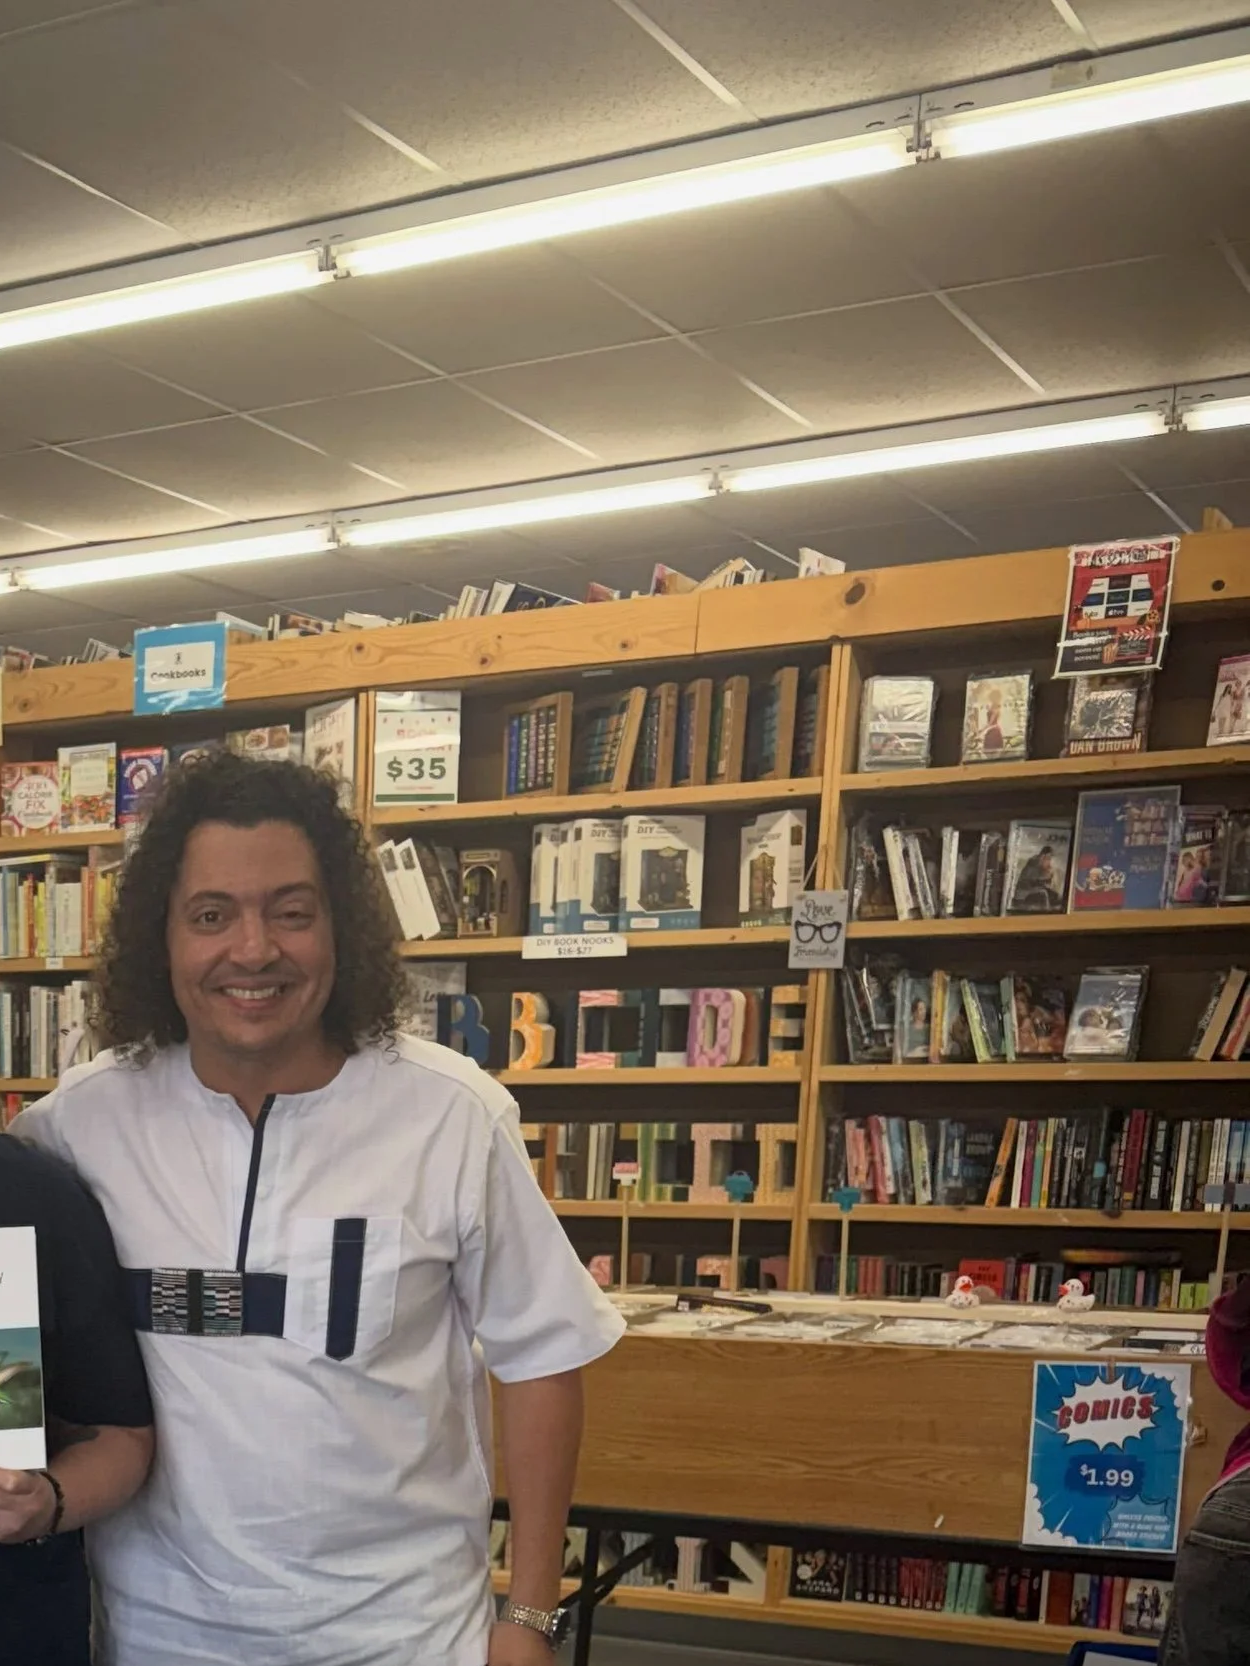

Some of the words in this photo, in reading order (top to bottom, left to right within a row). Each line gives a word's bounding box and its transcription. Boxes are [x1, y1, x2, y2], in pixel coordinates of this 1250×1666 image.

[1070, 739, 1096, 755] DAN
[1098, 732, 1141, 753] BROWN
[386, 756, 446, 782] $35
[25, 800, 46, 810] FIX
[637, 827, 655, 835] DIY
[554, 937, 580, 946] BOOK
[582, 936, 615, 945] NOOKS
[1056, 1394, 1154, 1430] COMICS
[1079, 1463, 1135, 1488] $1.99
